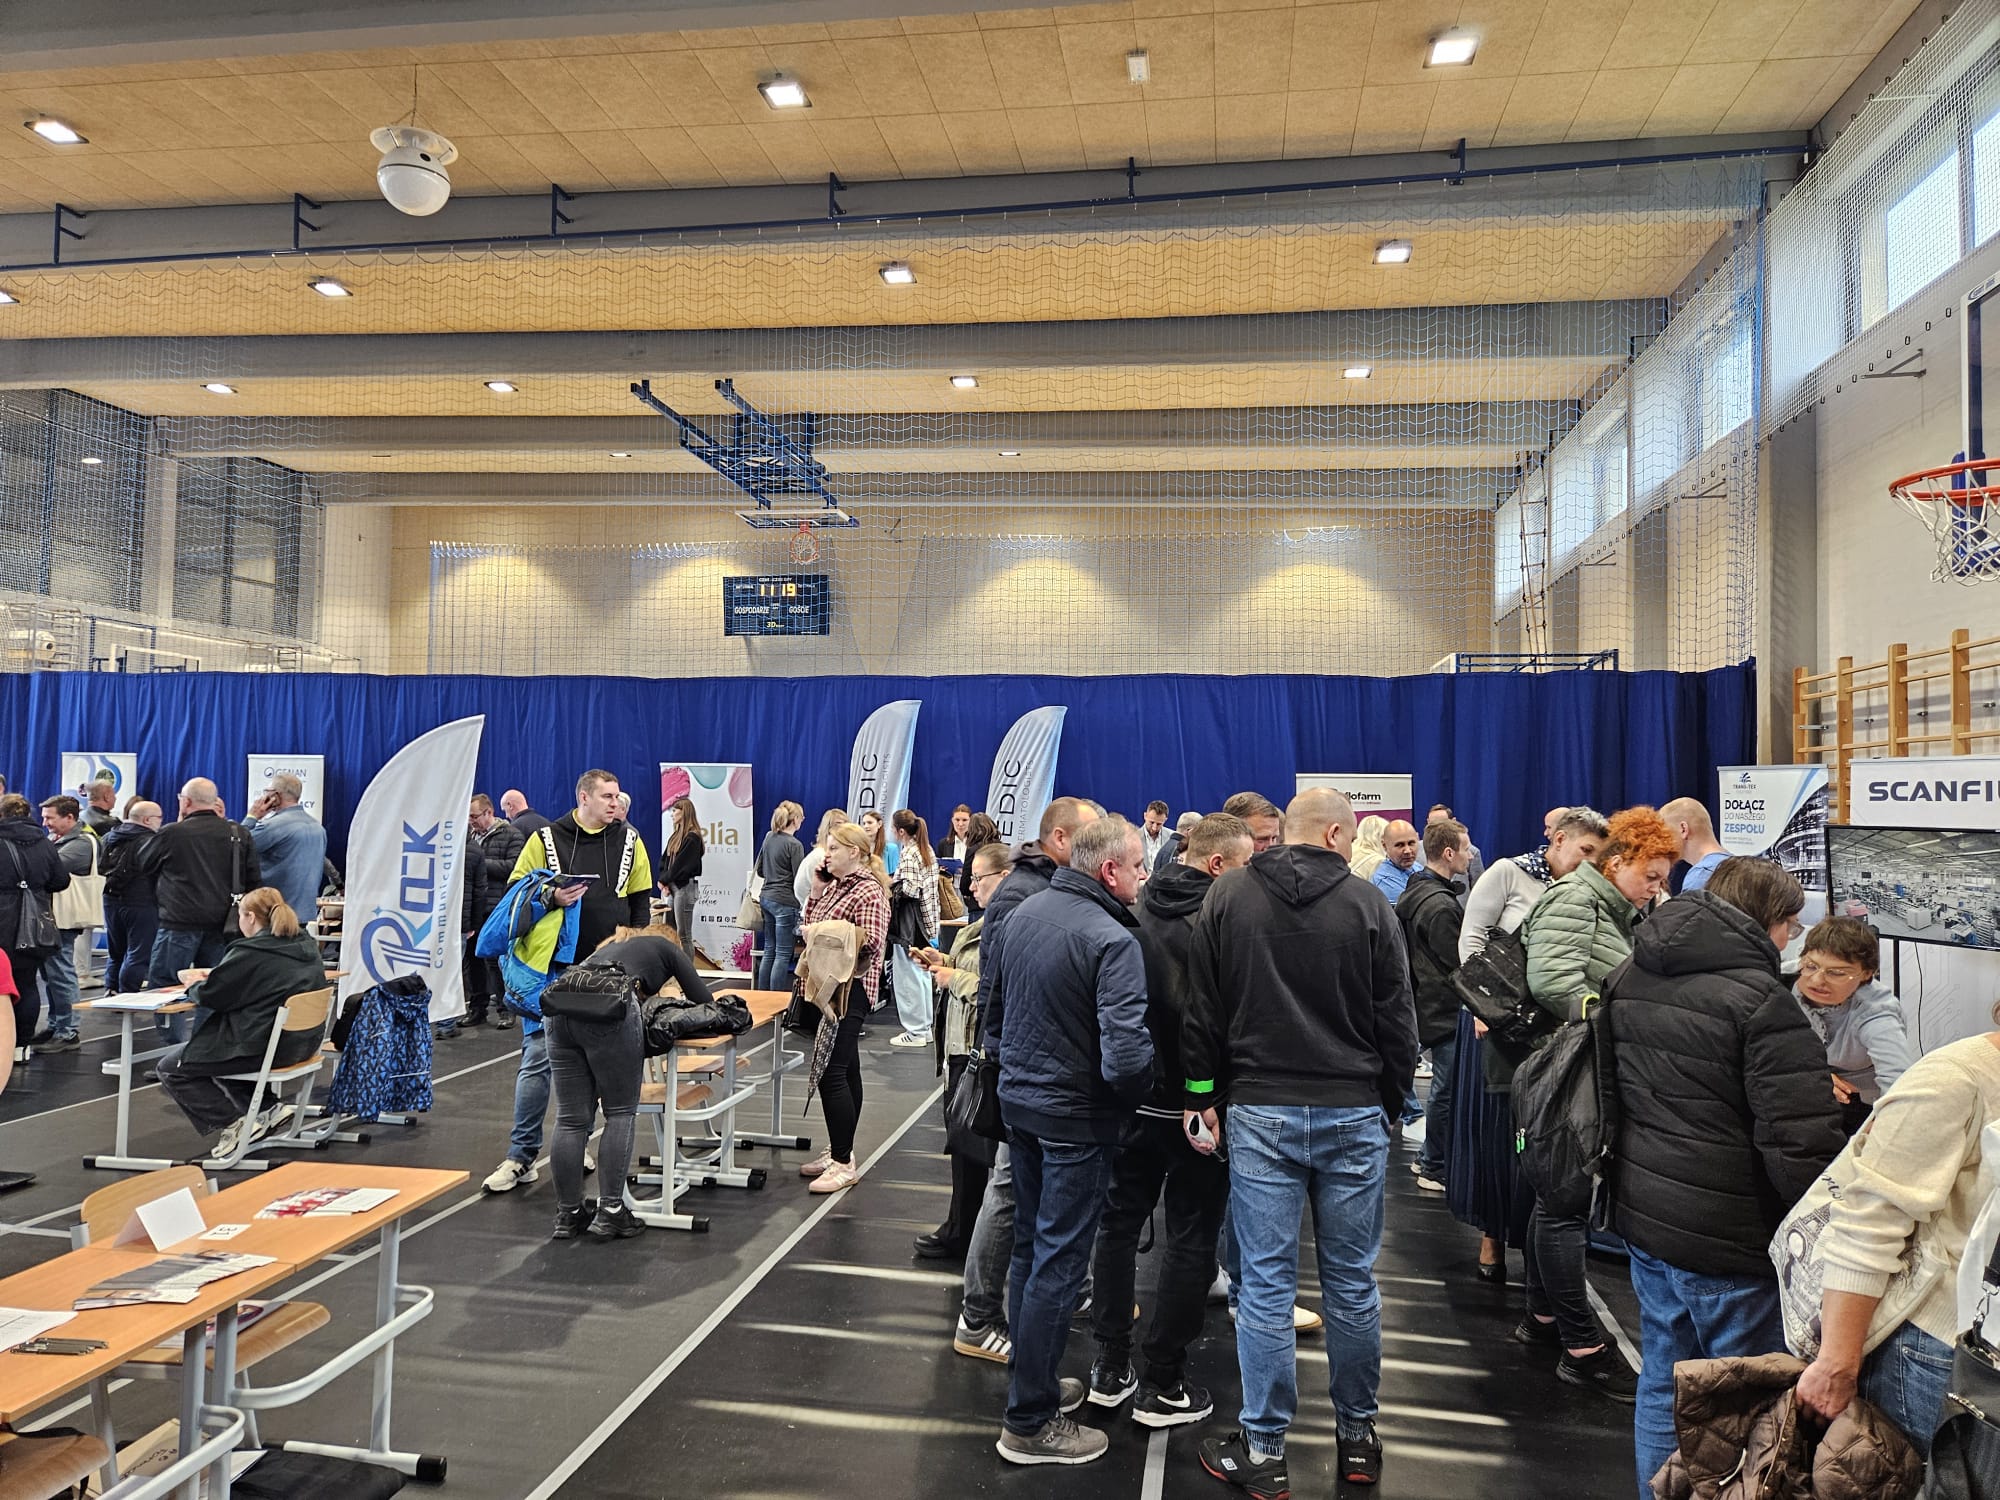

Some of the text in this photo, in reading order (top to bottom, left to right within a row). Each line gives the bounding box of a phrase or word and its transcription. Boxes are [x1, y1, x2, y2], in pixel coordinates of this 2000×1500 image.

[734, 606, 769, 614] GOSPODARZE
[1868, 780, 2000, 802] SCANFI
[1016, 760, 1034, 843] ERMATOLOGISTS
[1725, 799, 1765, 814] DOŁĄCZ
[1724, 812, 1766, 821] DO NASZEGO
[1724, 823, 1765, 834] ZESPOŁU
[433, 819, 454, 969] Communication
